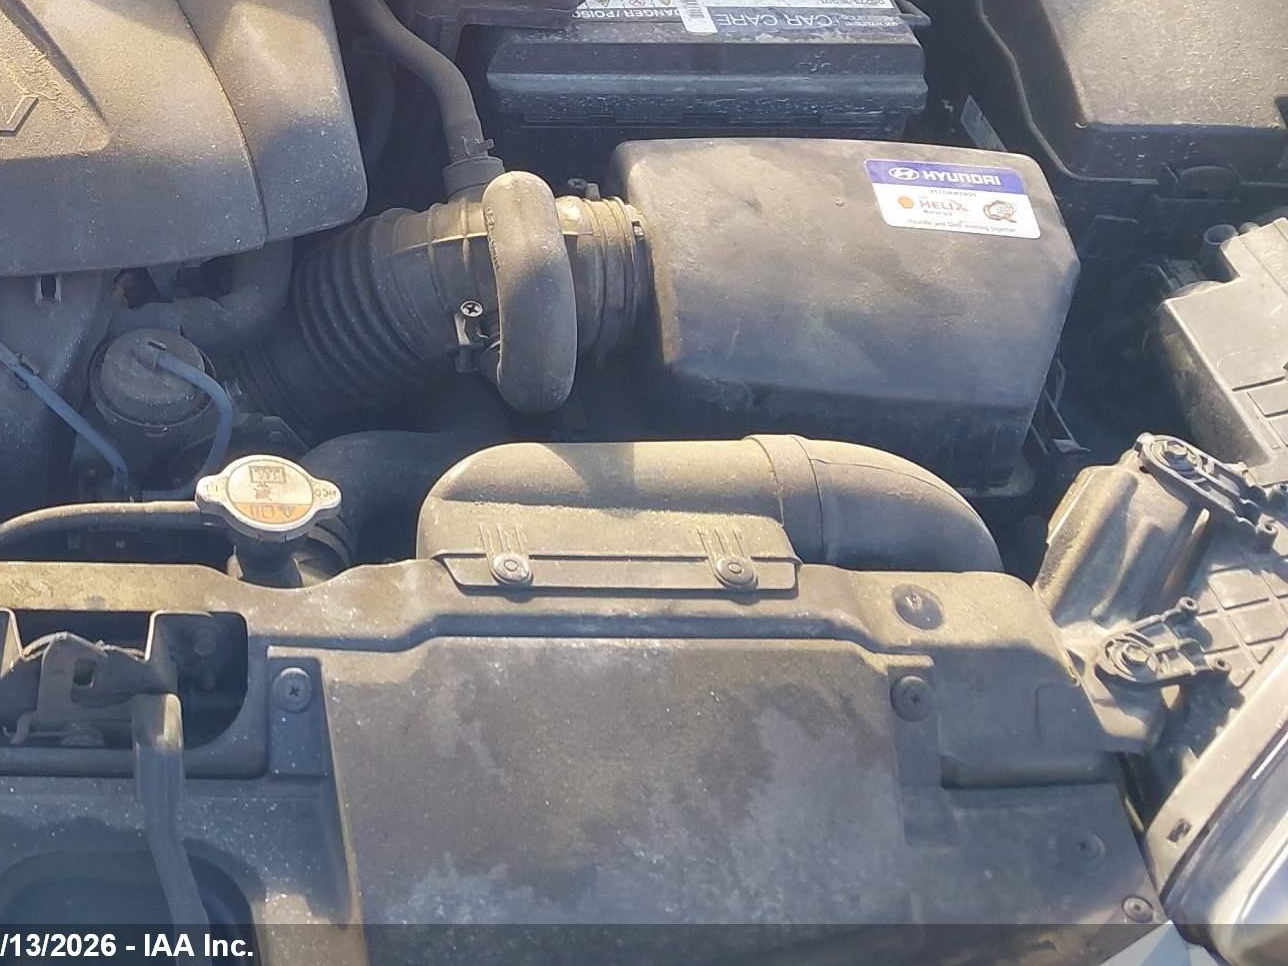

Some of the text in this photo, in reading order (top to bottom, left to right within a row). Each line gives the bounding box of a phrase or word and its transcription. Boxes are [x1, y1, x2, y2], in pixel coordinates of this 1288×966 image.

[716, 13, 778, 27] CARE
[787, 13, 832, 27] CAR
[922, 169, 1002, 186] HYUNDAI
[919, 199, 968, 212] HELIX
